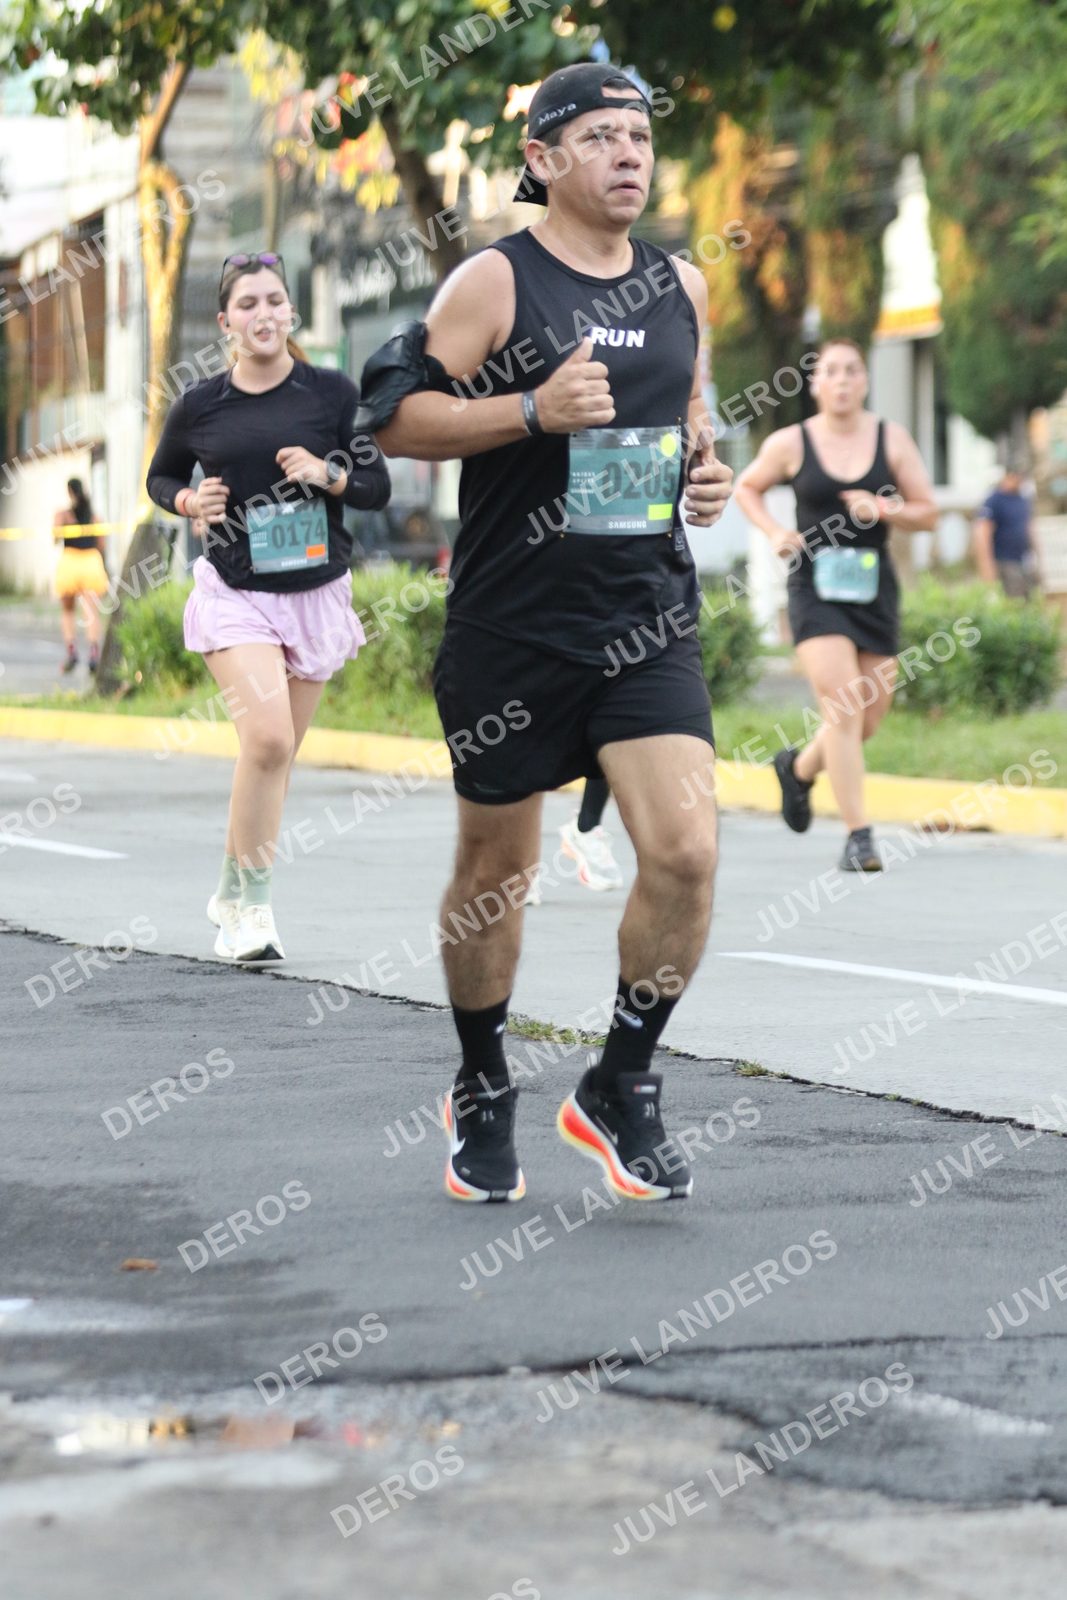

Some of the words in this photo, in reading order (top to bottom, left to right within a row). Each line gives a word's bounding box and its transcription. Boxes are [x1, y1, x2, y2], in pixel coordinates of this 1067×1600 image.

[538, 103, 577, 126] Maya
[591, 327, 646, 348] RUN
[601, 460, 676, 499] 0205
[271, 517, 327, 550] 0174
[608, 520, 648, 530] SAMSUNG
